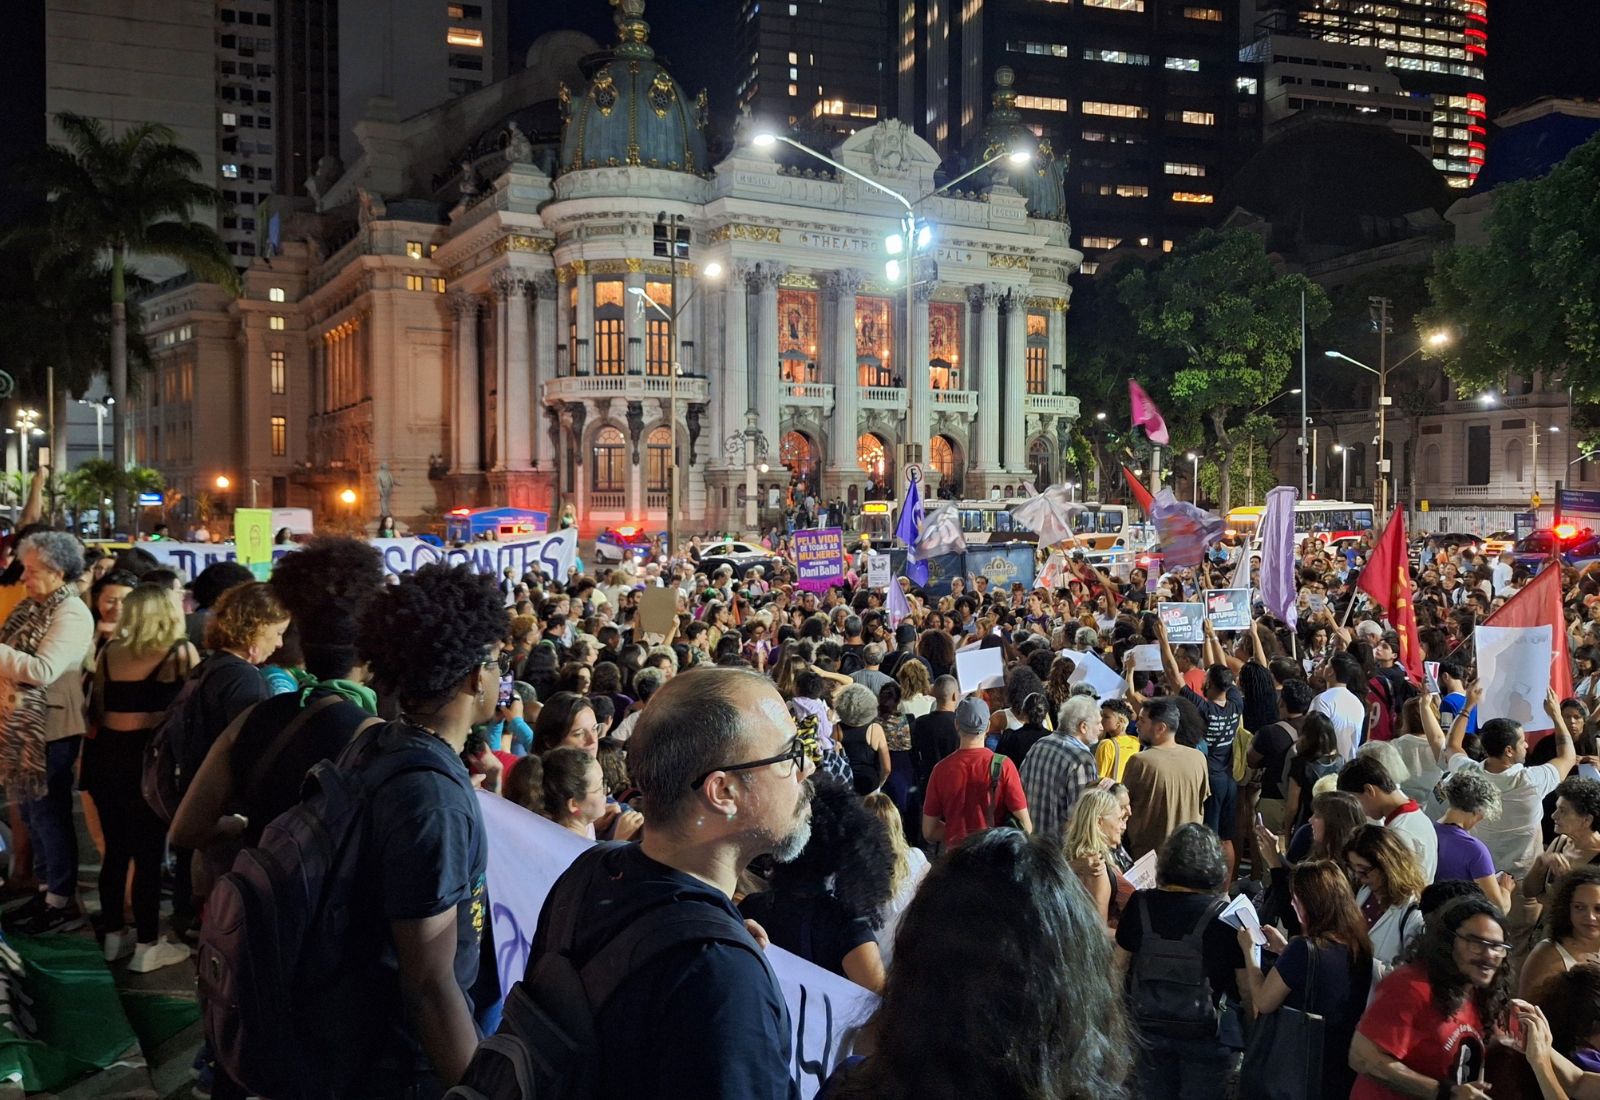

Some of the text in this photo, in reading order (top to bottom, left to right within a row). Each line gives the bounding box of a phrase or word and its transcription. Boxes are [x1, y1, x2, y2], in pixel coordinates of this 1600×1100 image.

[812, 235, 878, 251] THEATRO
[797, 534, 840, 546] PELA VIDA
[799, 550, 840, 560] MULHERES
[800, 564, 840, 577] Dani Balbi
[1209, 611, 1238, 620] ESTUPRO
[1166, 625, 1192, 634] STUPRO
